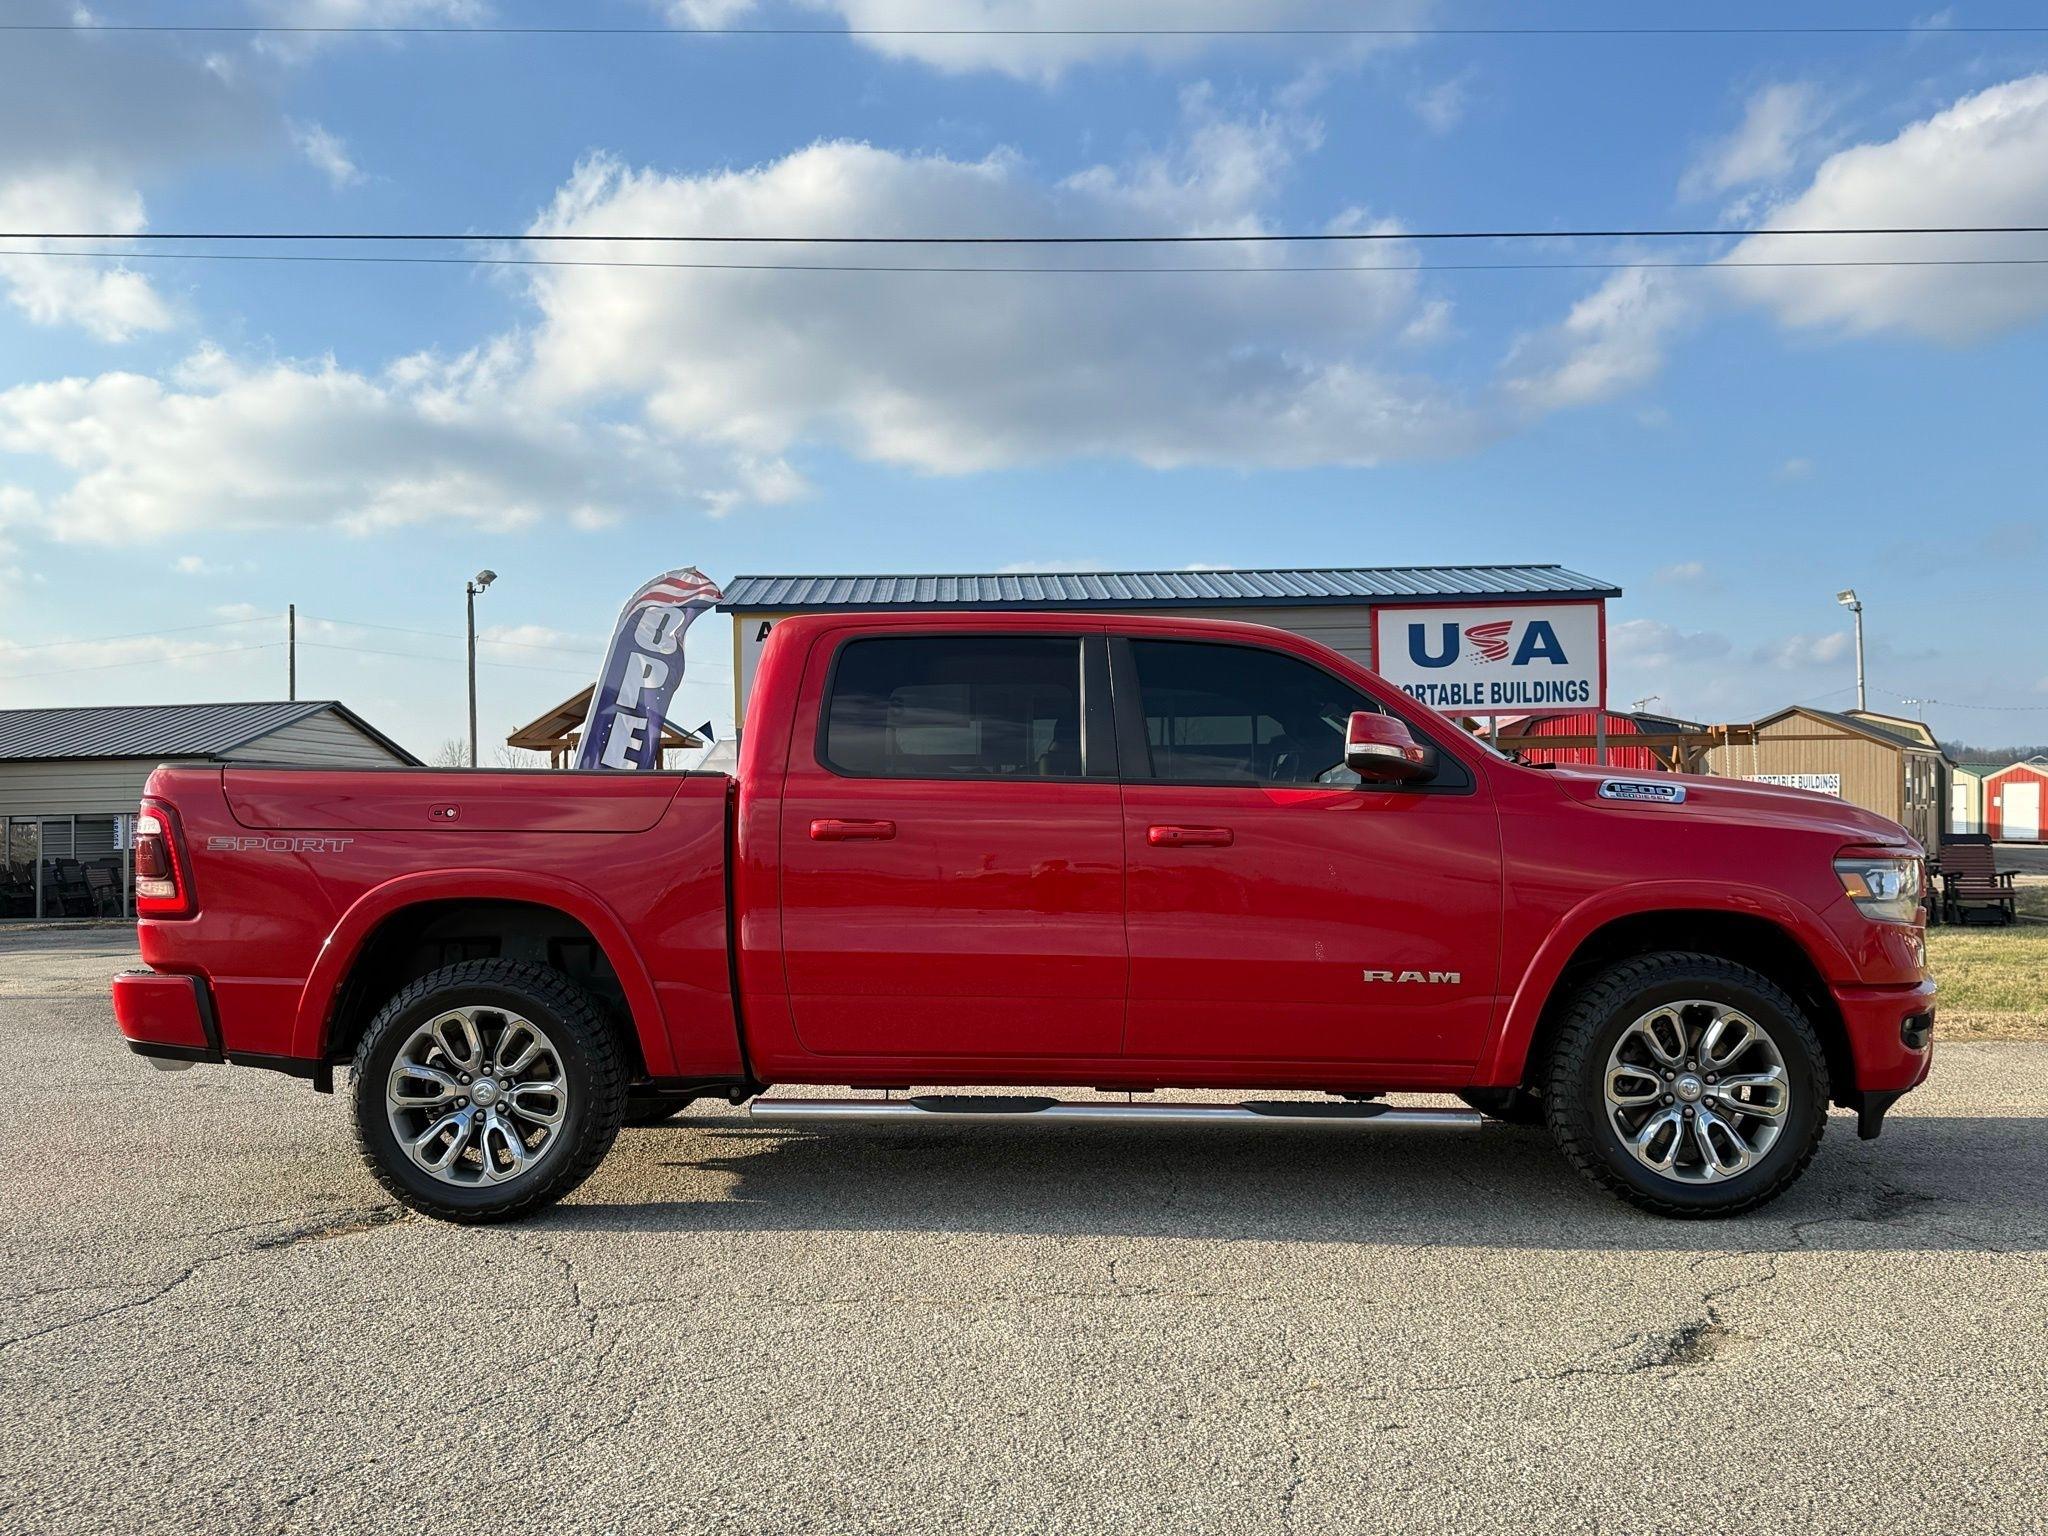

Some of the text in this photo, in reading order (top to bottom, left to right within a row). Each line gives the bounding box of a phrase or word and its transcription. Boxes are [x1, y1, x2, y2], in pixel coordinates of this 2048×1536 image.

[1408, 620, 1569, 668] USA
[1395, 680, 1590, 705] ORTABLE BUILDINGS
[1606, 783, 1675, 796] 1500
[1798, 775, 1838, 789] BUILDINGS
[207, 836, 354, 853] SPORT
[1363, 970, 1461, 984] RAM
